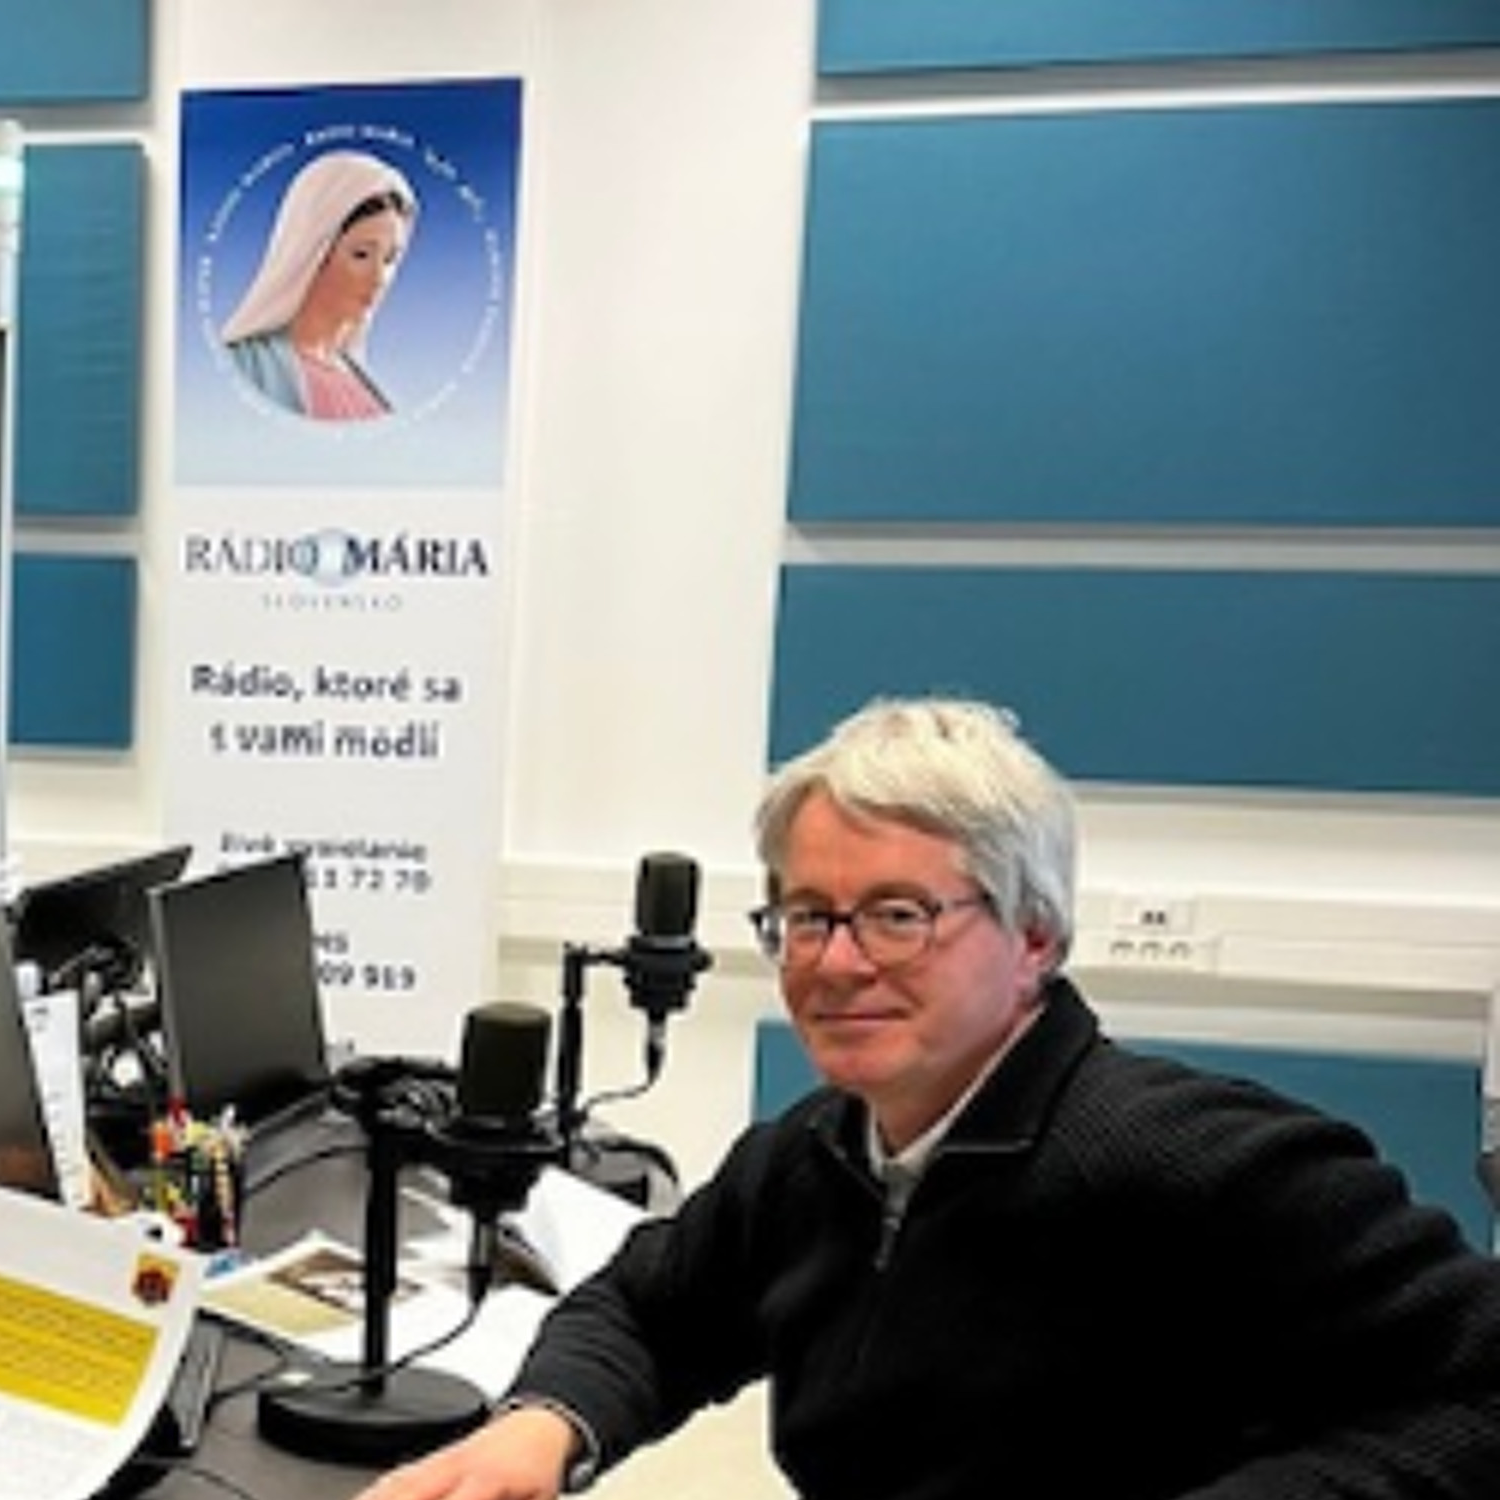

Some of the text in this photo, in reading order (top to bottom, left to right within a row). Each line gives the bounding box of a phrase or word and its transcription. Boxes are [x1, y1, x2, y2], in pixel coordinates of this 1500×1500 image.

[341, 530, 490, 577] MÁRIA
[190, 661, 464, 702] Rádio, ktoré sa
[234, 718, 326, 756] vami
